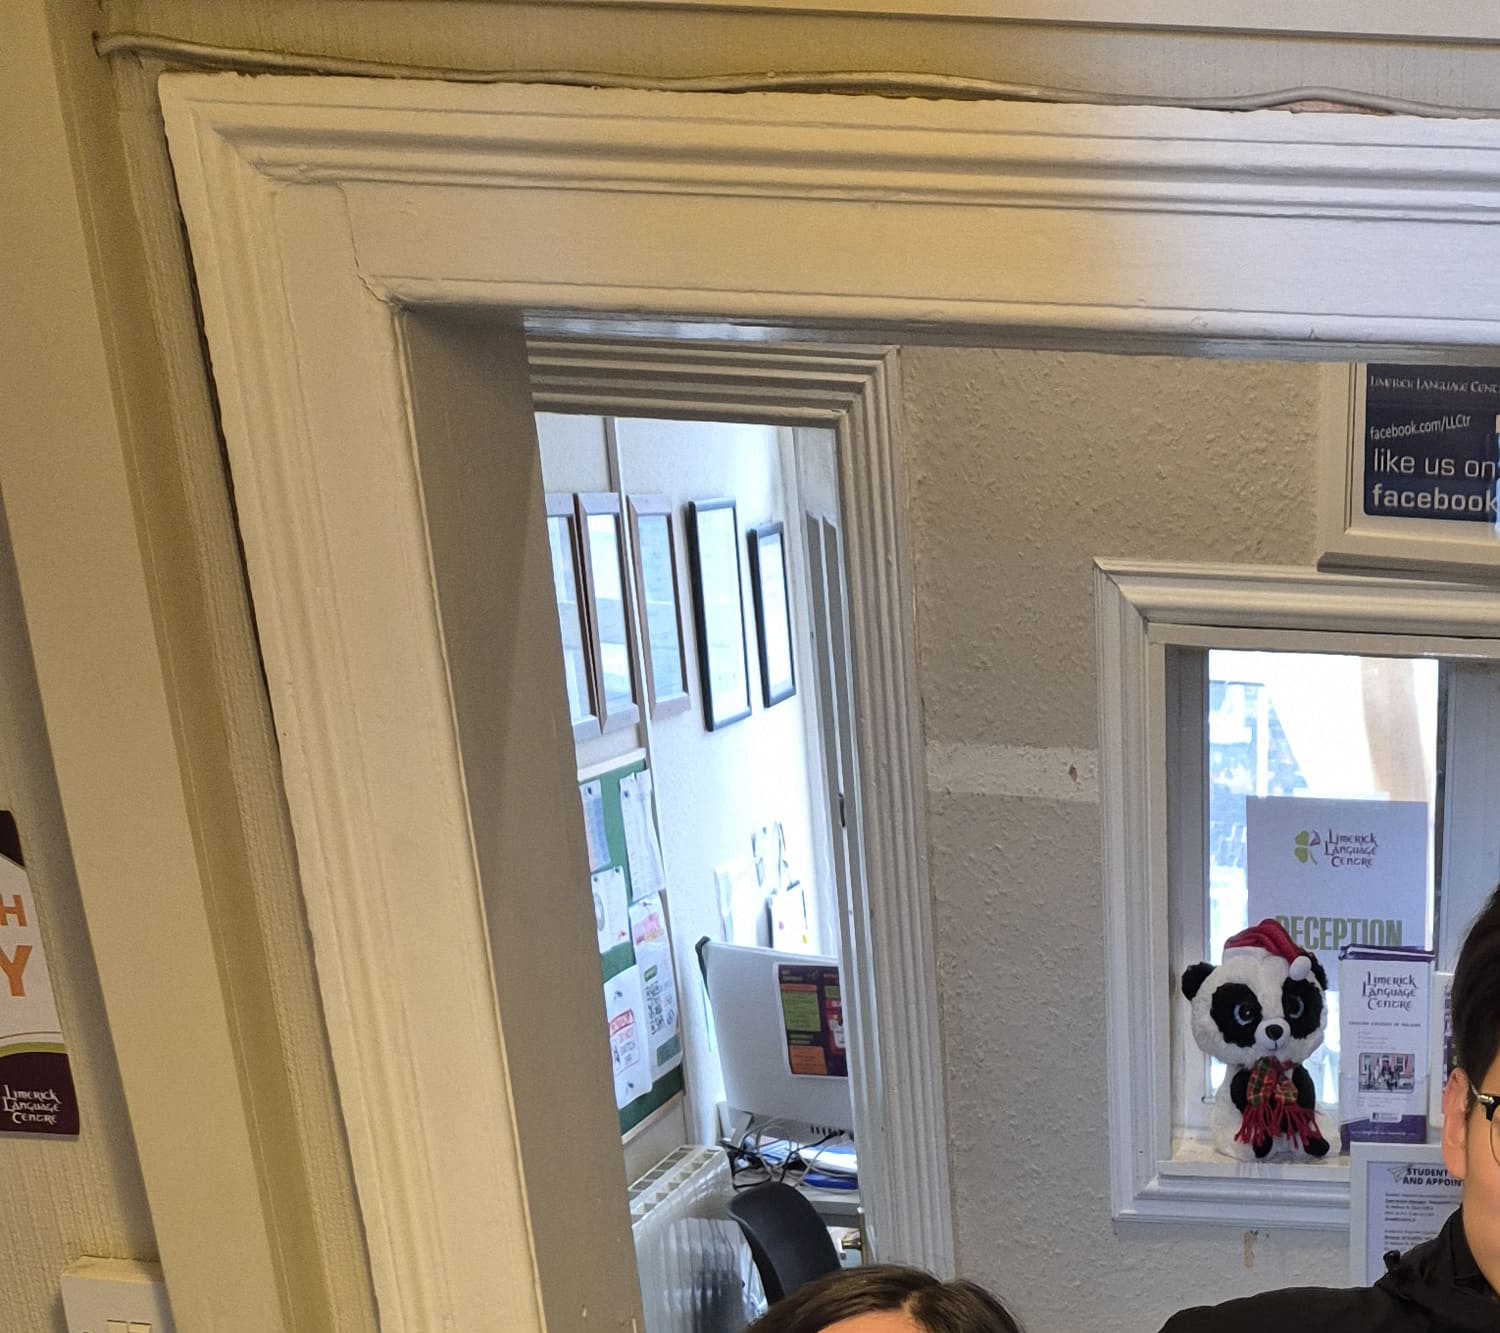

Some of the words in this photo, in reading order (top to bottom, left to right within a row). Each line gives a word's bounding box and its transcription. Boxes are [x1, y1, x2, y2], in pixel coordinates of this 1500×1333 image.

[1370, 414, 1471, 440] facebook.com/LLCtr
[1373, 448, 1415, 474] like
[1424, 459, 1455, 476] us
[1464, 460, 1496, 479] on
[1372, 483, 1498, 513] facebook
[1402, 1177, 1424, 1185] AND
[1426, 1178, 1462, 1187] APPOIN
[1407, 1167, 1449, 1177] STUDENT
